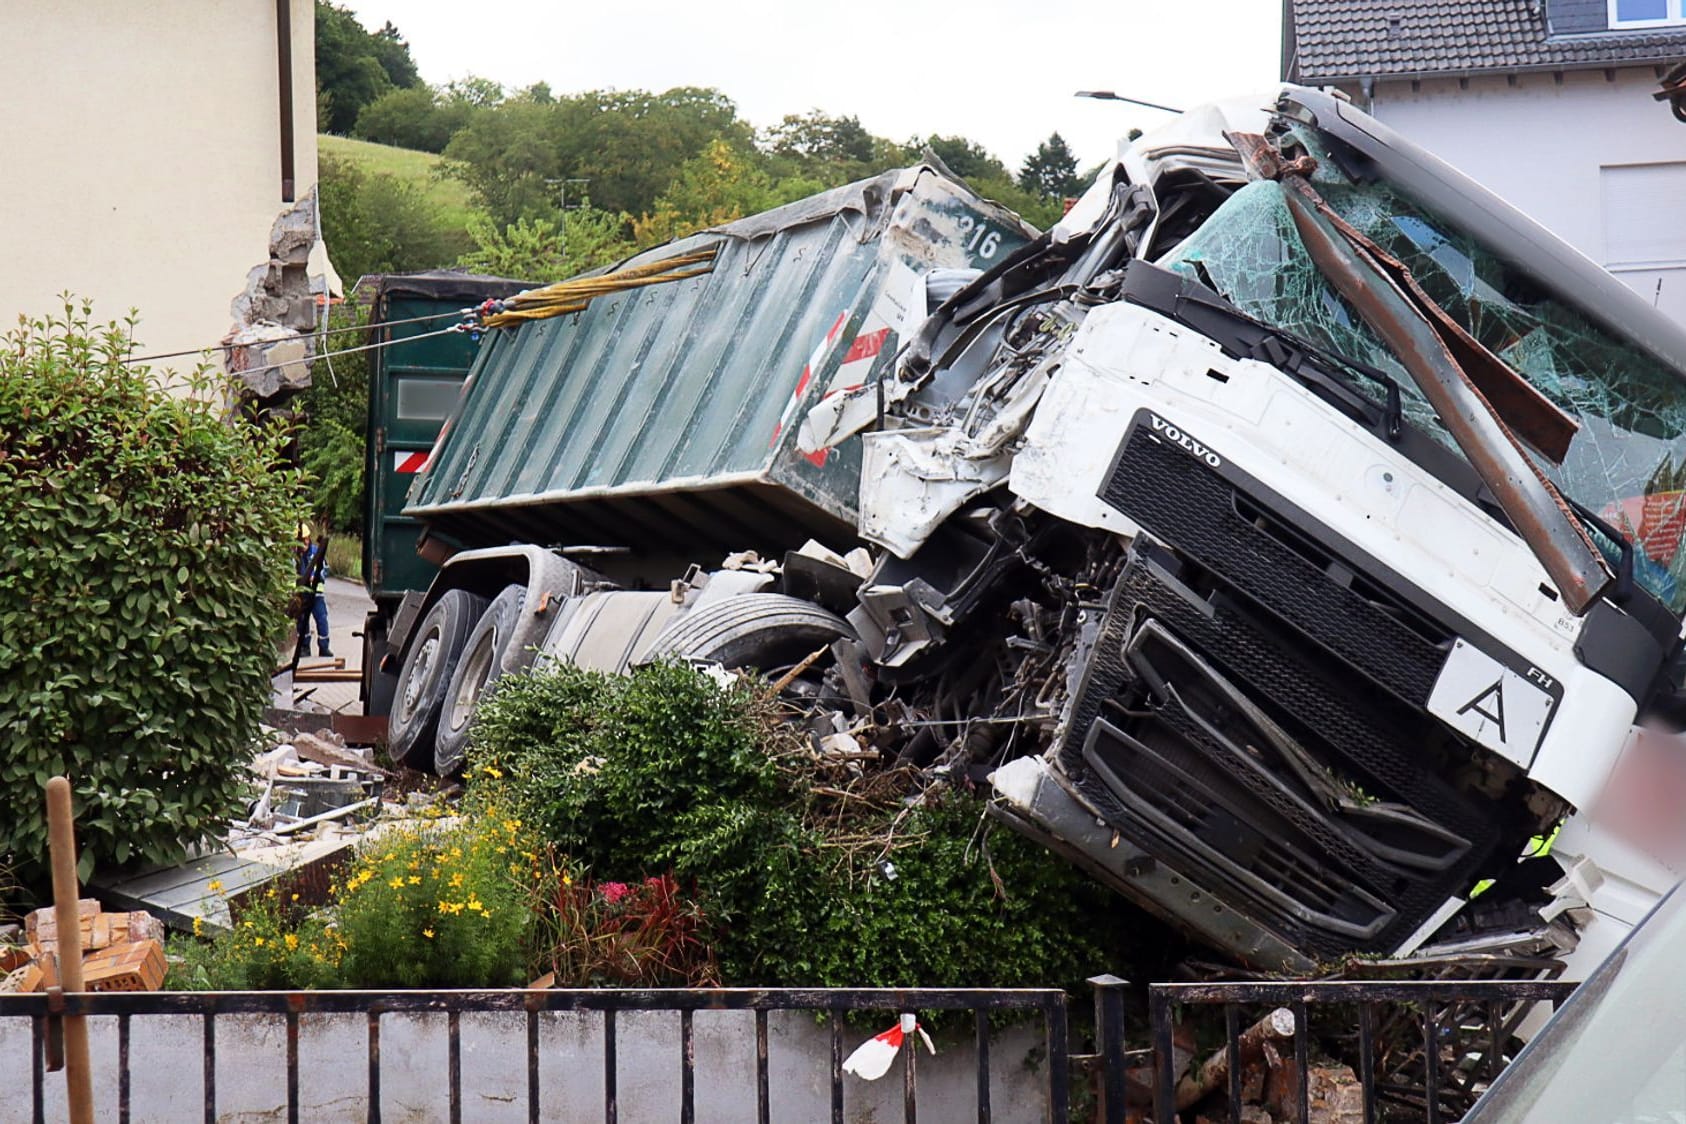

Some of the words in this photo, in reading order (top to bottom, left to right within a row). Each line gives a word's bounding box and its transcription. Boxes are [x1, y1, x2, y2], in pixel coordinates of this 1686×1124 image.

[1150, 414, 1221, 468] VOLVO
[1526, 666, 1553, 689] FH
[1455, 679, 1506, 744] A
